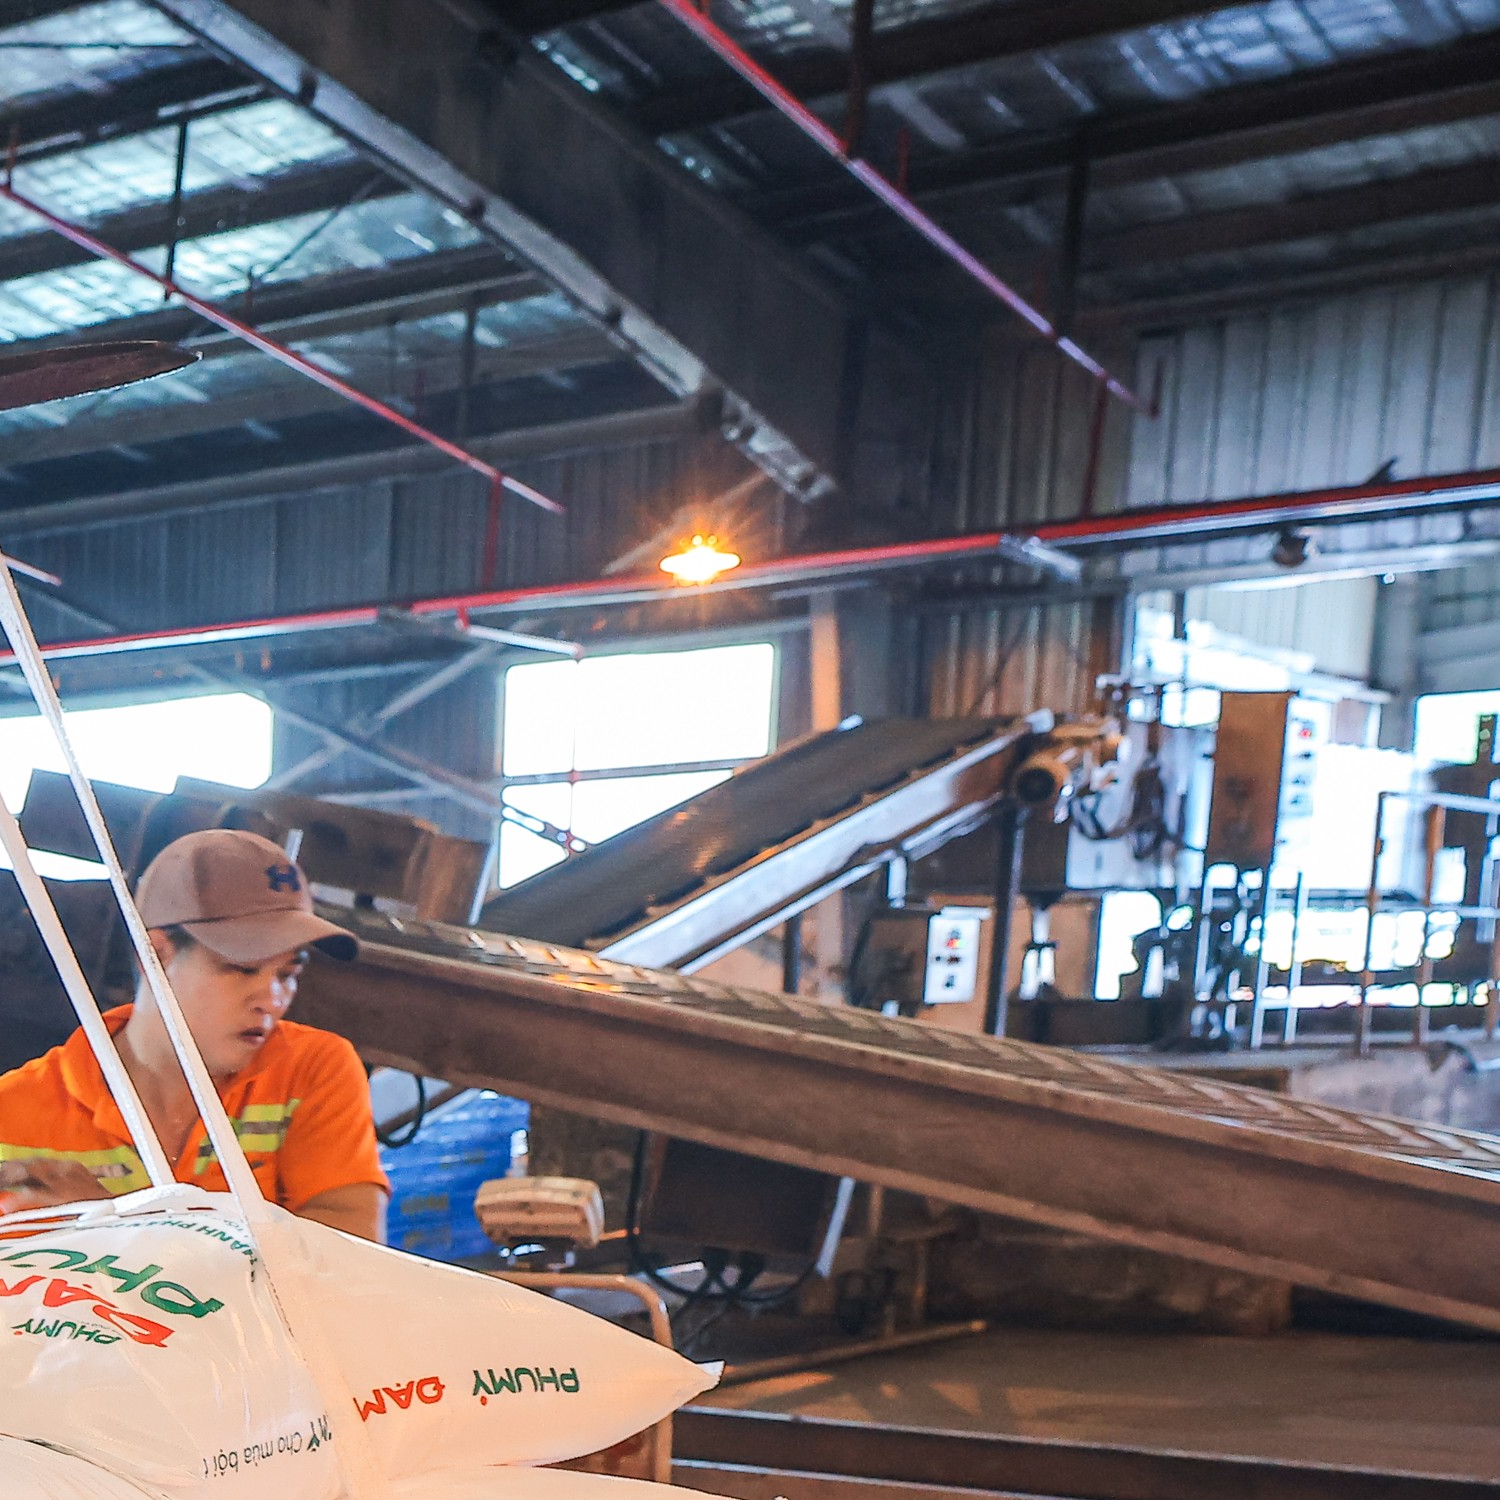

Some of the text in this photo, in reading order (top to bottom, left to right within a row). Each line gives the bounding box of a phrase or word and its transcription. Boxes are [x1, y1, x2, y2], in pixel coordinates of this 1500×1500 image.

[12, 1317, 123, 1345] PHUMY
[353, 1376, 446, 1422] ĐẠM
[472, 1367, 580, 1406] PHUMY
[244, 1439, 274, 1467] mùa
[278, 1429, 303, 1454] Cho
[213, 1446, 239, 1478] bội
